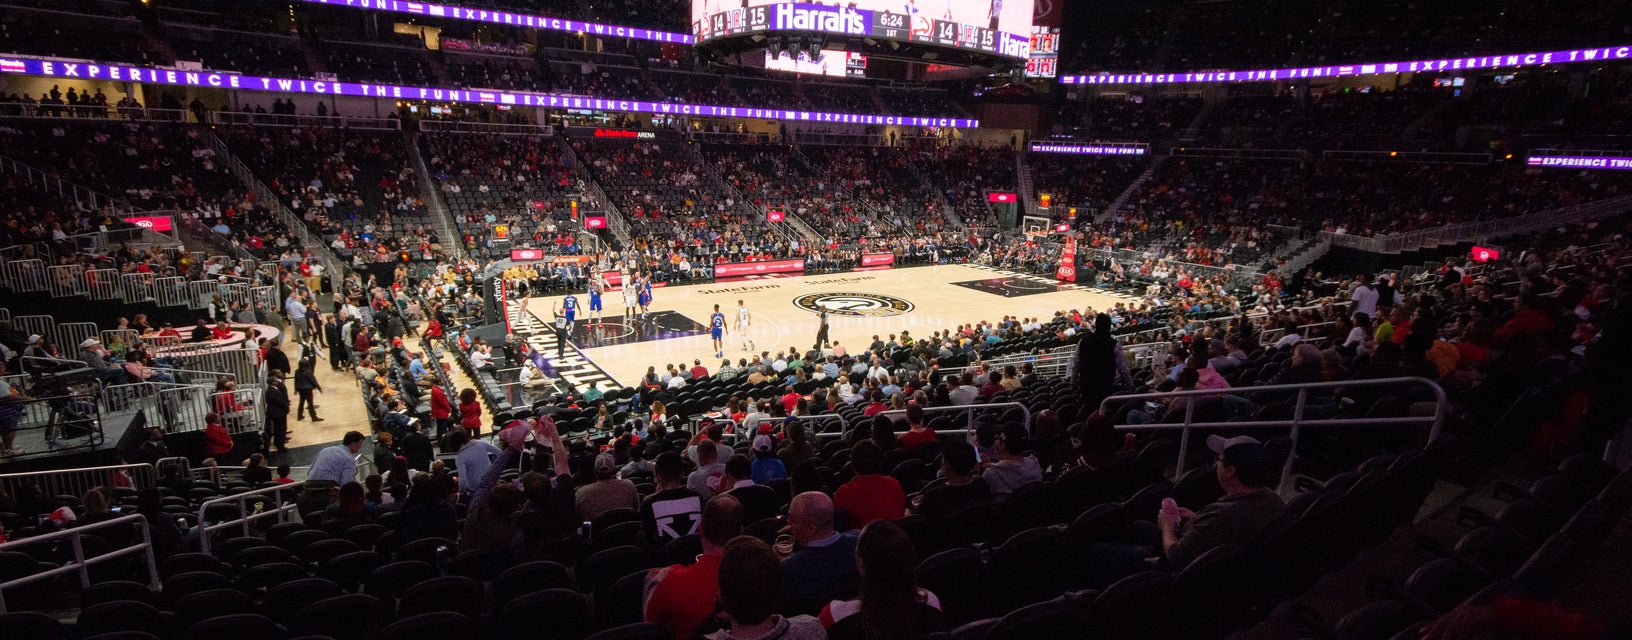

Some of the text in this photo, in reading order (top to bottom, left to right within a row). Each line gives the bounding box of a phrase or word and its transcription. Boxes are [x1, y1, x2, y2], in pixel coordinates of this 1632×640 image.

[714, 15, 724, 31] 14
[751, 8, 765, 25] 15
[776, 3, 866, 35] Harrah's
[880, 14, 903, 27] 6:24
[453, 8, 572, 30] EXPERIENCE
[584, 23, 635, 38] TWICE
[646, 31, 672, 42] THE
[886, 29, 898, 37] 1ST
[939, 23, 953, 39] 14
[981, 30, 993, 46] 15
[1409, 53, 1553, 72] EXPERIENCE
[1569, 47, 1630, 61] TWIC
[42, 62, 240, 87] EXPERIENCE
[261, 78, 342, 94] TWICE
[361, 85, 401, 97] THE
[1079, 74, 1175, 84] EXPERIENCE
[1186, 72, 1236, 82] TWICE
[1248, 70, 1277, 79] THE
[524, 96, 639, 111] EXPERIENCE
[652, 103, 700, 114] TWICE
[711, 107, 736, 116] THE
[816, 113, 902, 124] EXPERIENCE
[912, 118, 956, 127] TWICE
[1542, 158, 1607, 167] EXPERIENCE
[493, 277, 502, 302] xfinity
